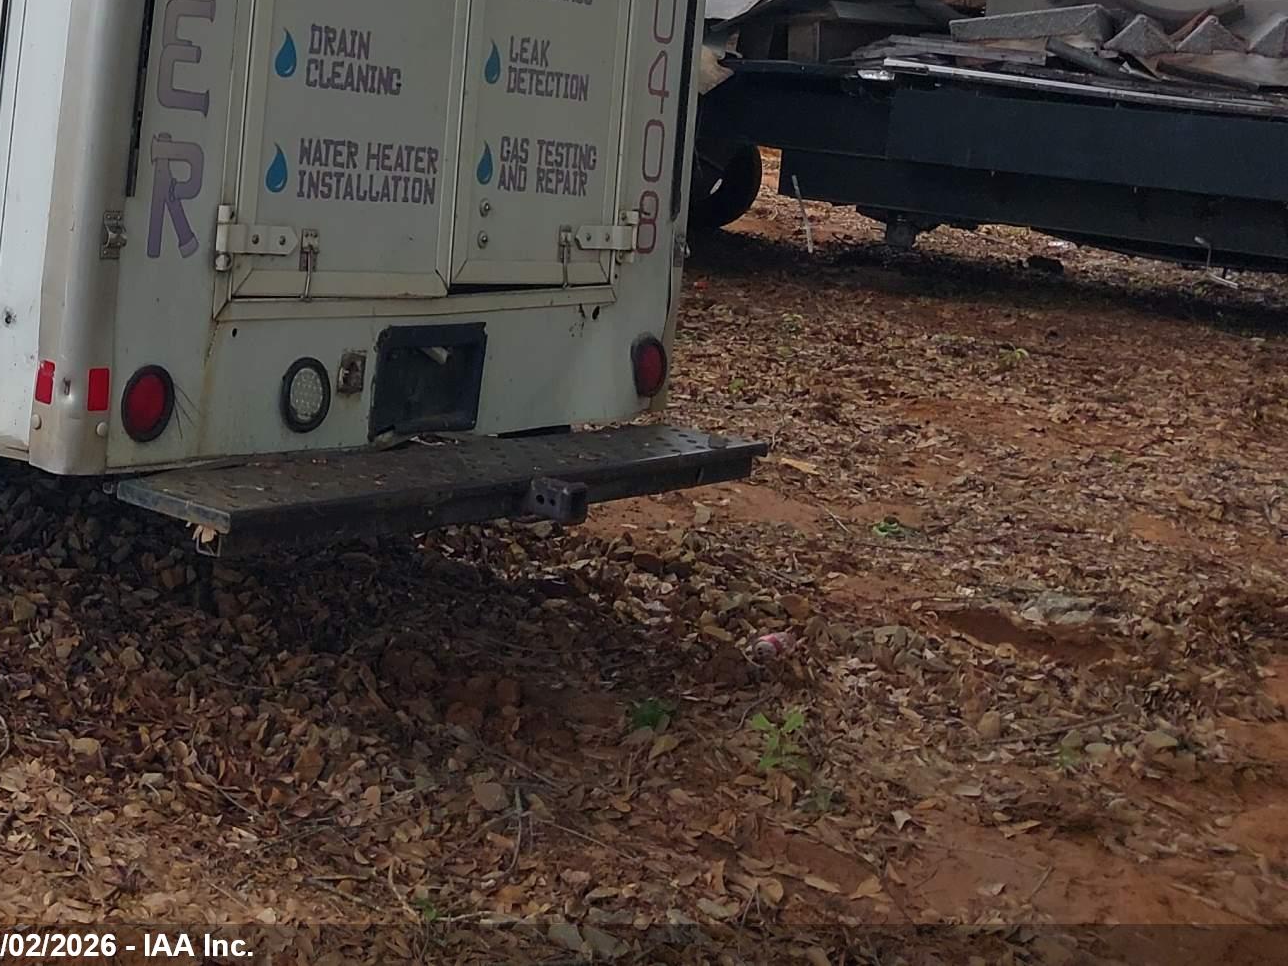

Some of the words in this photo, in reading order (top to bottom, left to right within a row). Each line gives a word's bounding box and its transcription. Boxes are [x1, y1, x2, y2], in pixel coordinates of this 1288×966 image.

[308, 24, 372, 60] DRAIN
[509, 35, 551, 68] LEAK
[305, 58, 402, 96] CLEANING
[506, 65, 590, 101] DETECTION
[299, 138, 359, 170] WATER
[367, 142, 440, 175] HEATER
[500, 136, 529, 165] GAS
[536, 139, 597, 171] TESTING
[296, 169, 437, 205] INSTALLATION
[497, 164, 527, 192] AND
[535, 169, 588, 197] REPAIR
